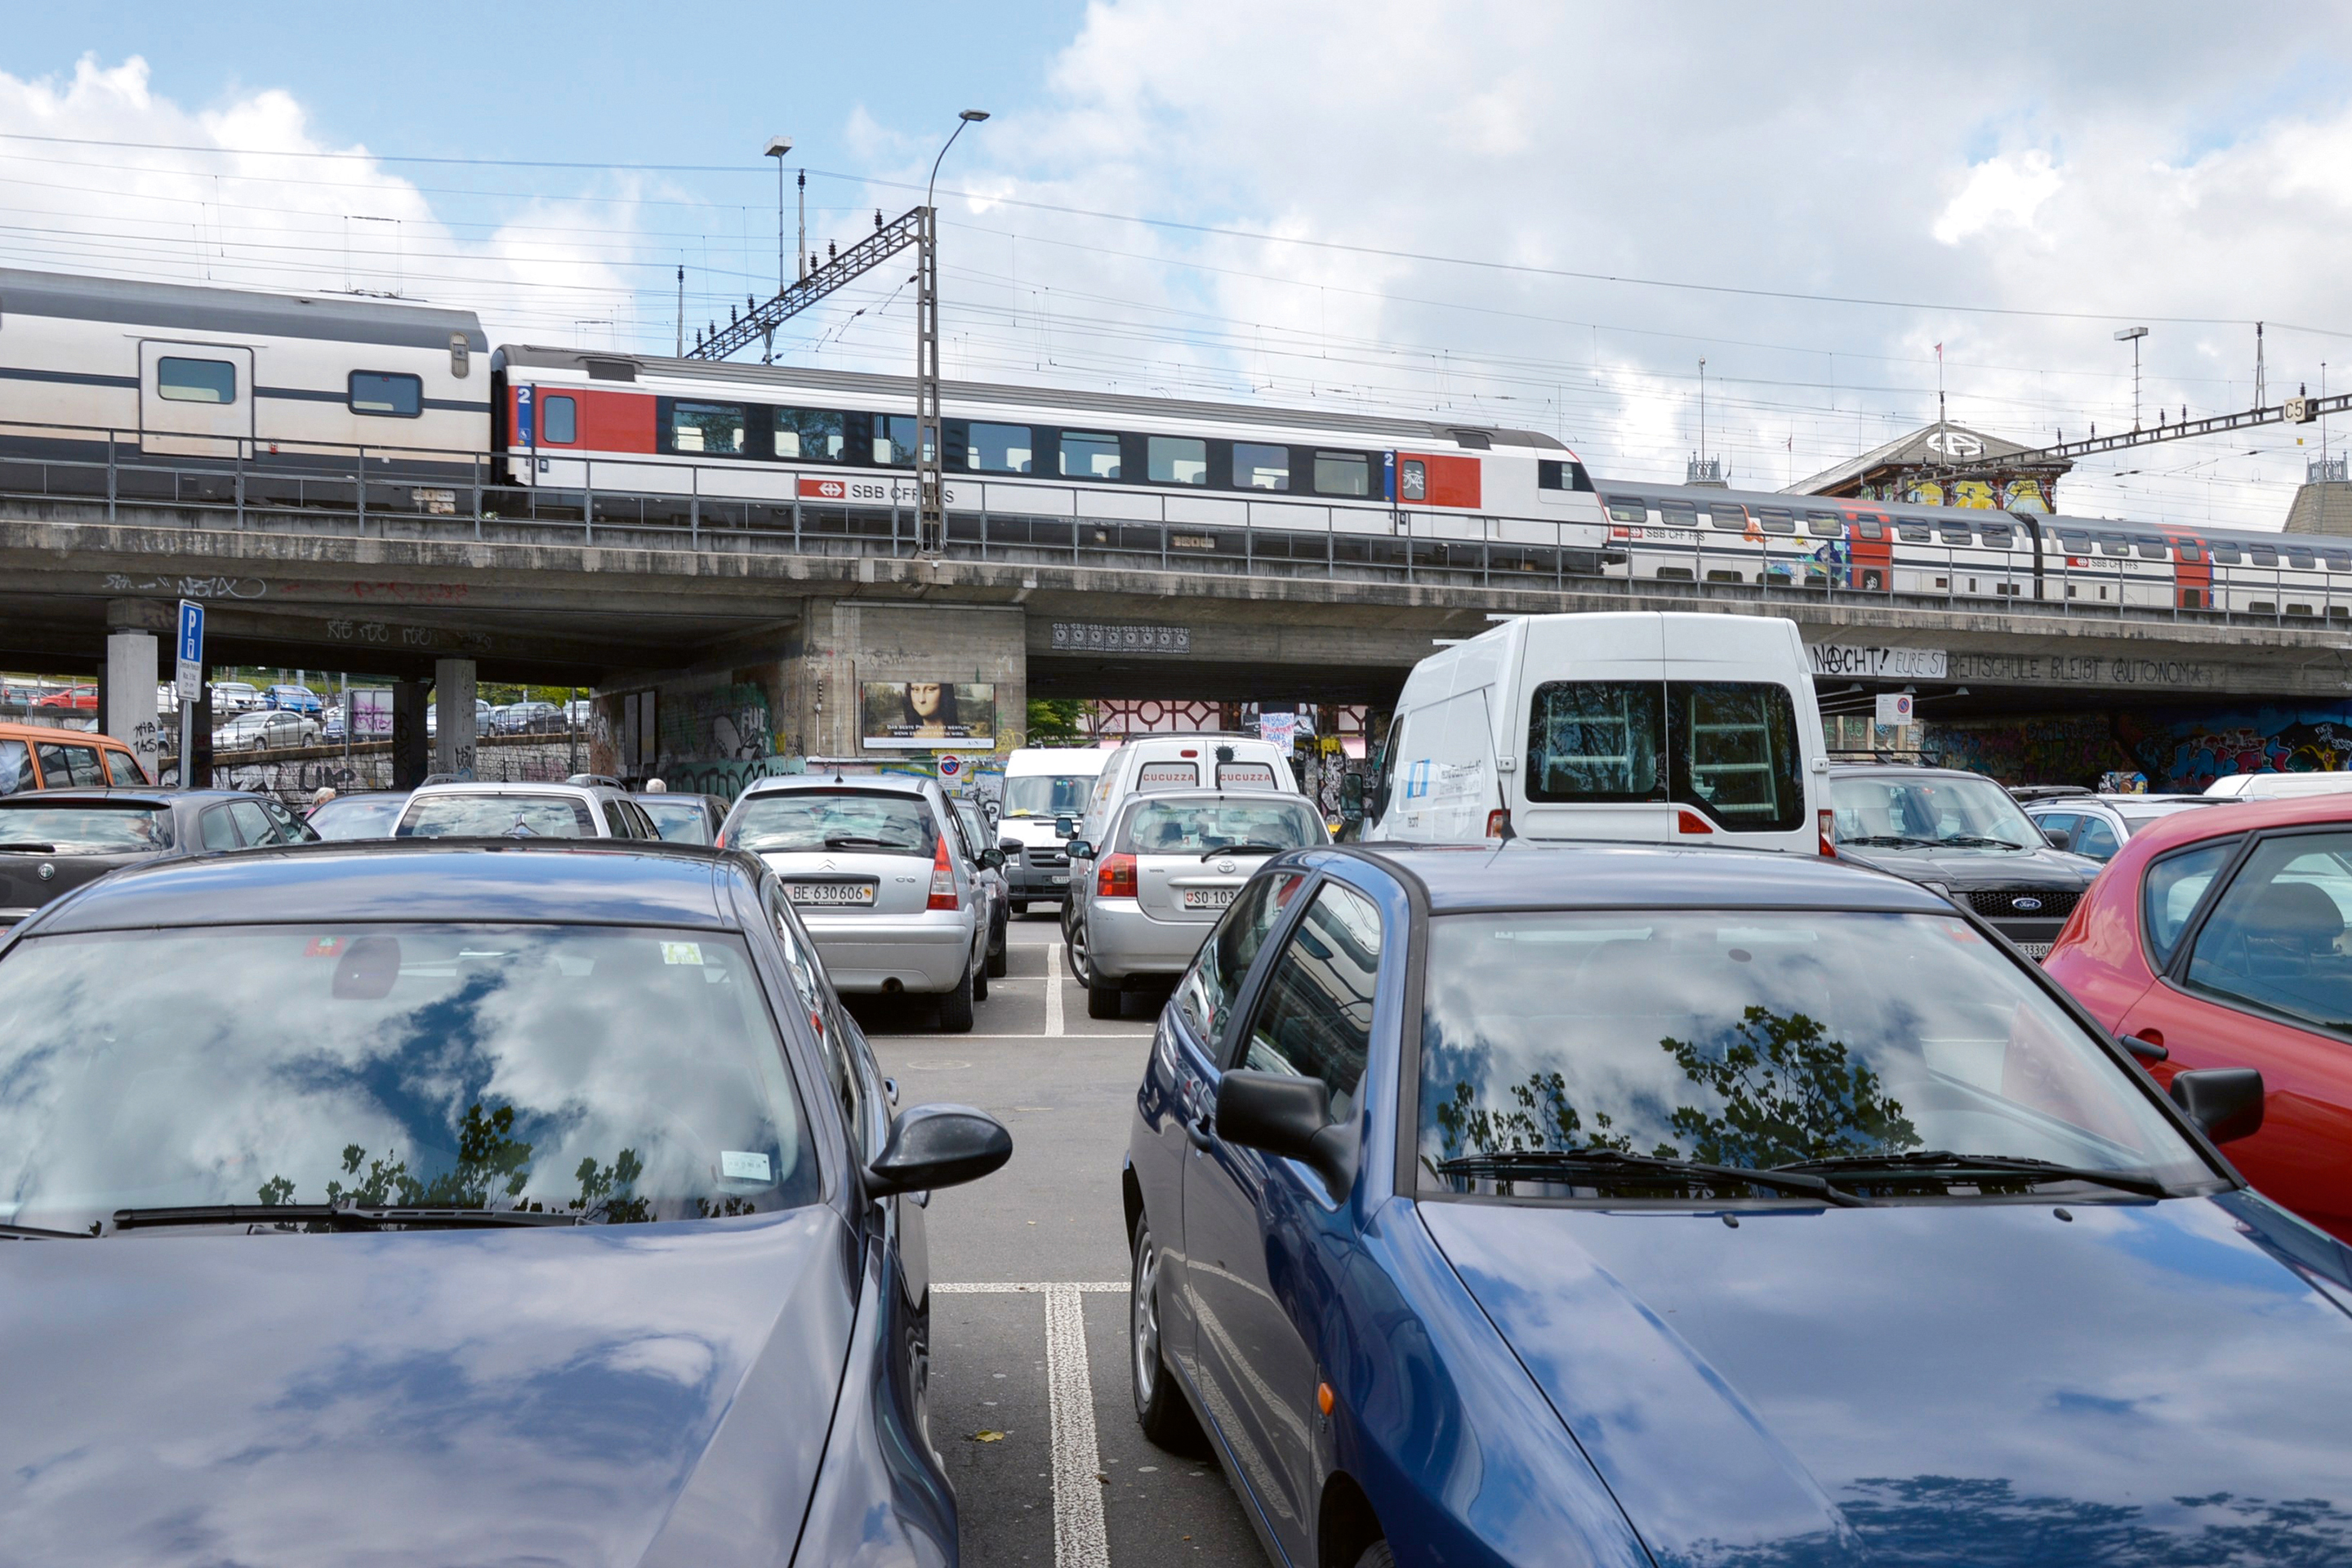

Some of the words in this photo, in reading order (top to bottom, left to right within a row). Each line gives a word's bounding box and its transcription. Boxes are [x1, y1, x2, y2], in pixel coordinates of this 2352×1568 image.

[518, 388, 531, 403] 2
[2285, 401, 2302, 419] C5
[1384, 453, 1393, 466] 2
[852, 484, 884, 499] SBB
[1646, 528, 1666, 538] SBB
[188, 609, 196, 637] P
[1895, 651, 1925, 675] EURE
[2050, 657, 2103, 680] BLEIBT
[1143, 773, 1194, 782] CUCUZZA
[1219, 773, 1270, 782] CUCUZZA
